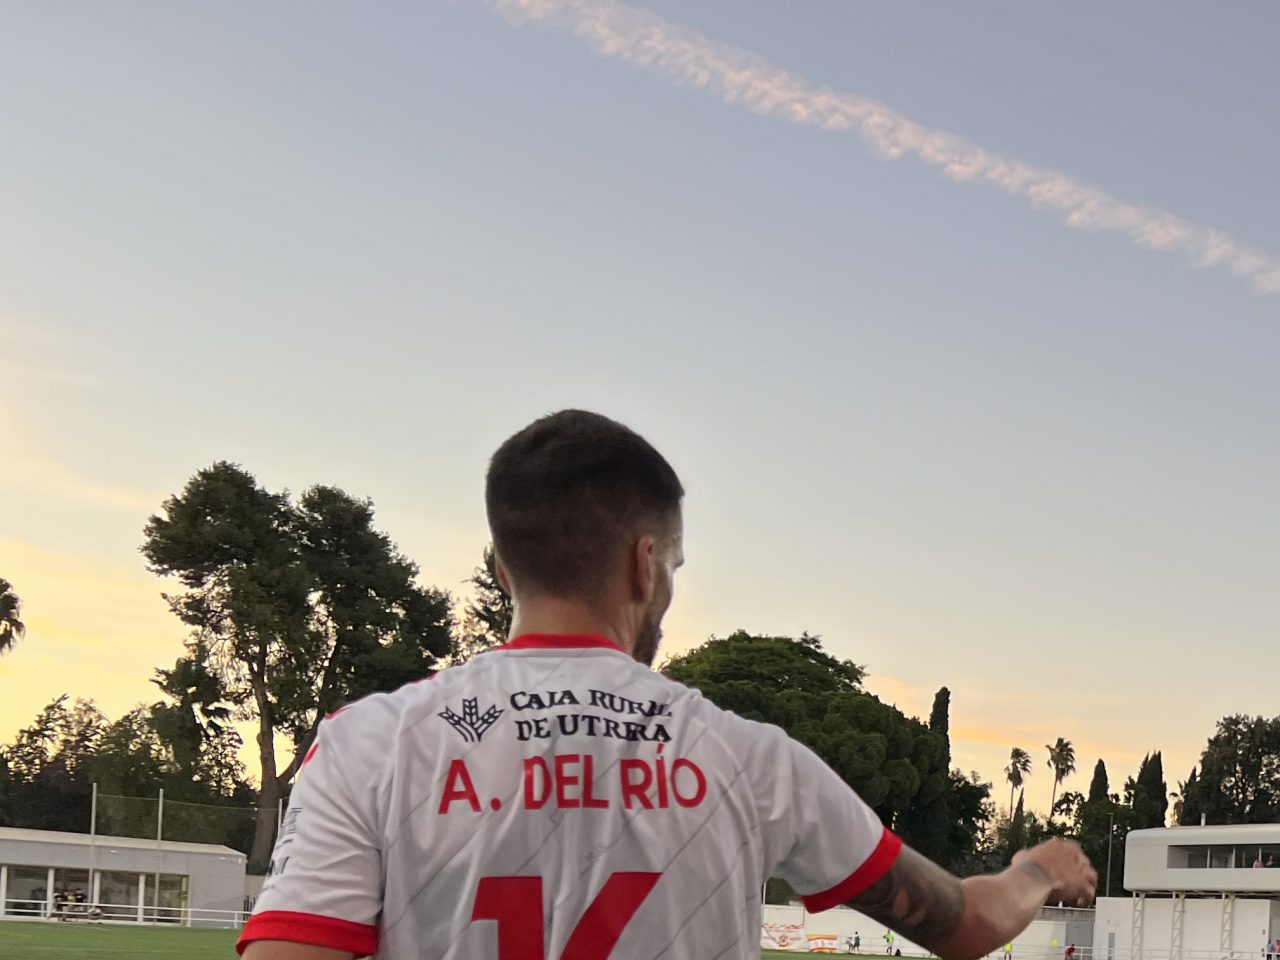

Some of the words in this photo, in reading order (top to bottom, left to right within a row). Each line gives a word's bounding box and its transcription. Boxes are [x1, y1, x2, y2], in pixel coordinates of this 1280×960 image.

[510, 690, 579, 711] CAJA
[515, 717, 551, 741] DE
[438, 758, 502, 814] A.
[524, 754, 609, 810] DEL
[620, 742, 707, 810] RÍO
